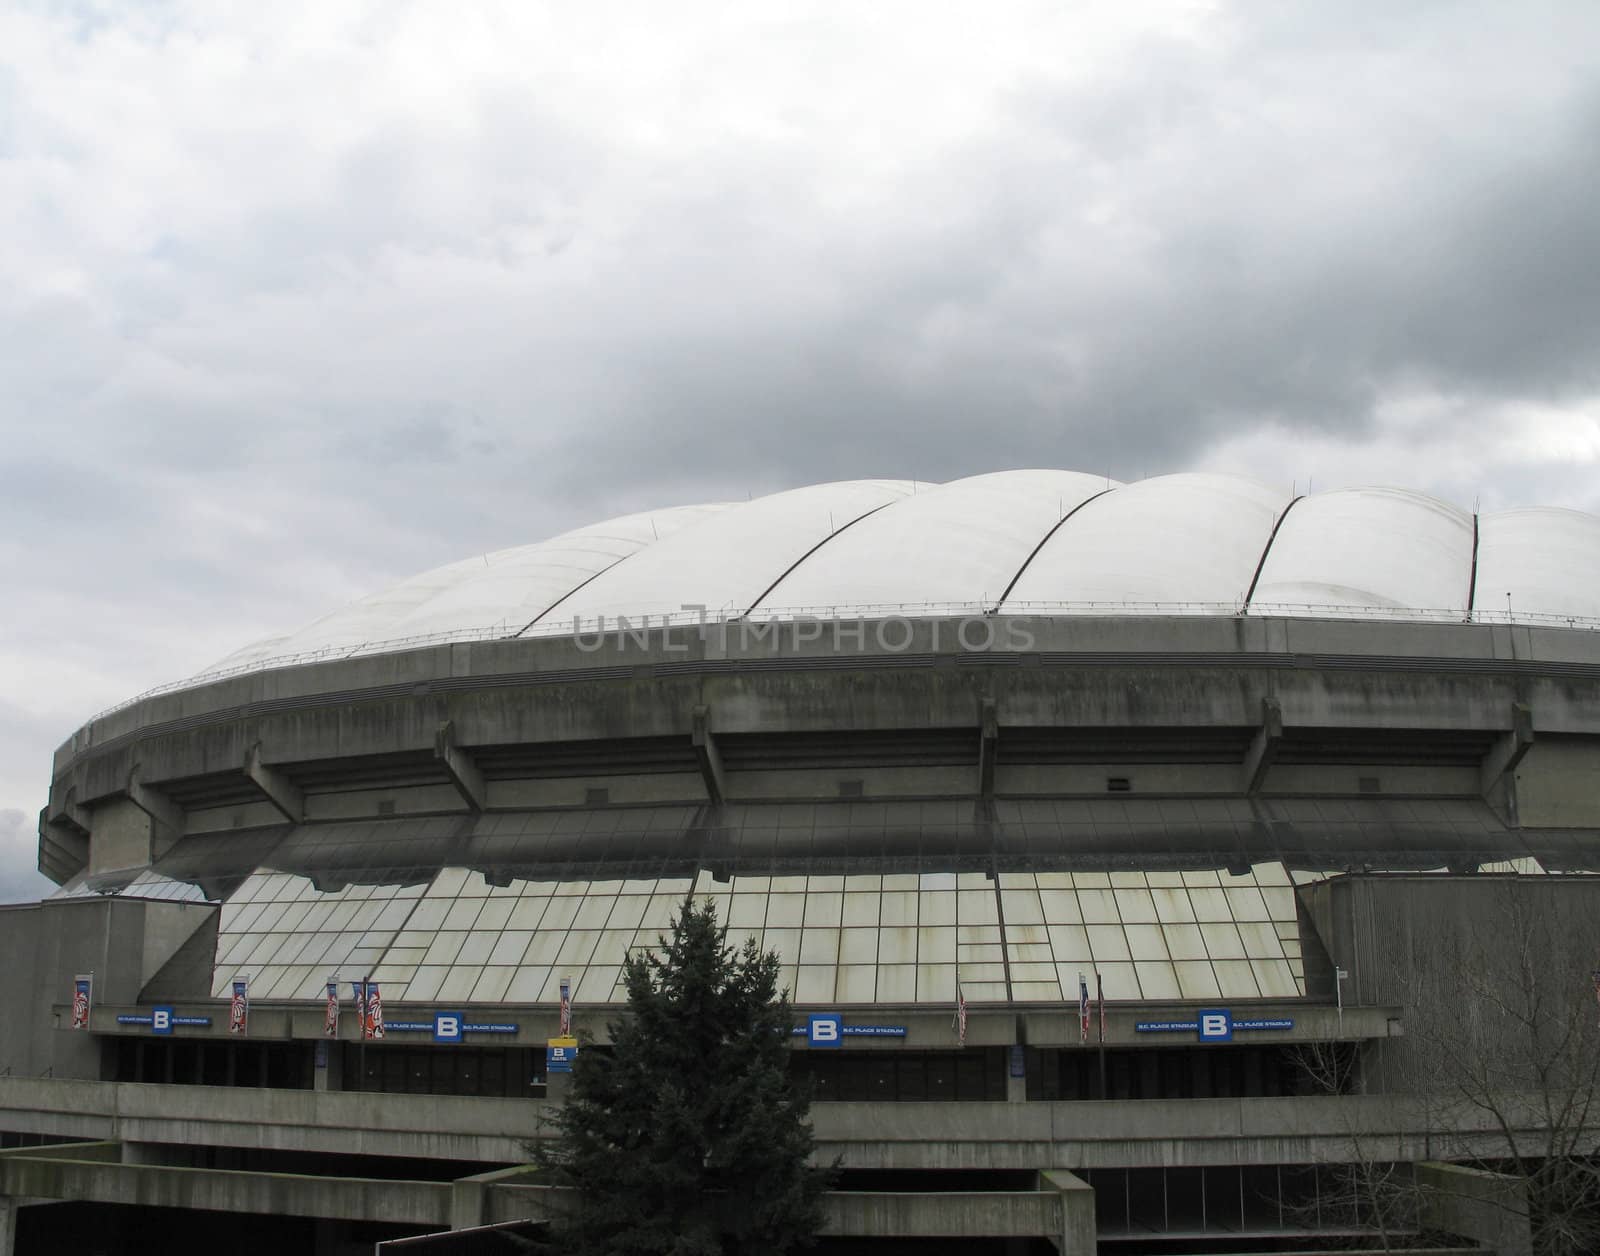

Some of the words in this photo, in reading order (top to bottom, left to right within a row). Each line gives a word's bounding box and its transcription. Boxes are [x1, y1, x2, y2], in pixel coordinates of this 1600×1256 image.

[154, 1011, 169, 1028] B
[437, 1017, 458, 1036] B
[1202, 1015, 1227, 1036] B
[812, 1020, 838, 1041] B
[554, 1048, 564, 1056] B
